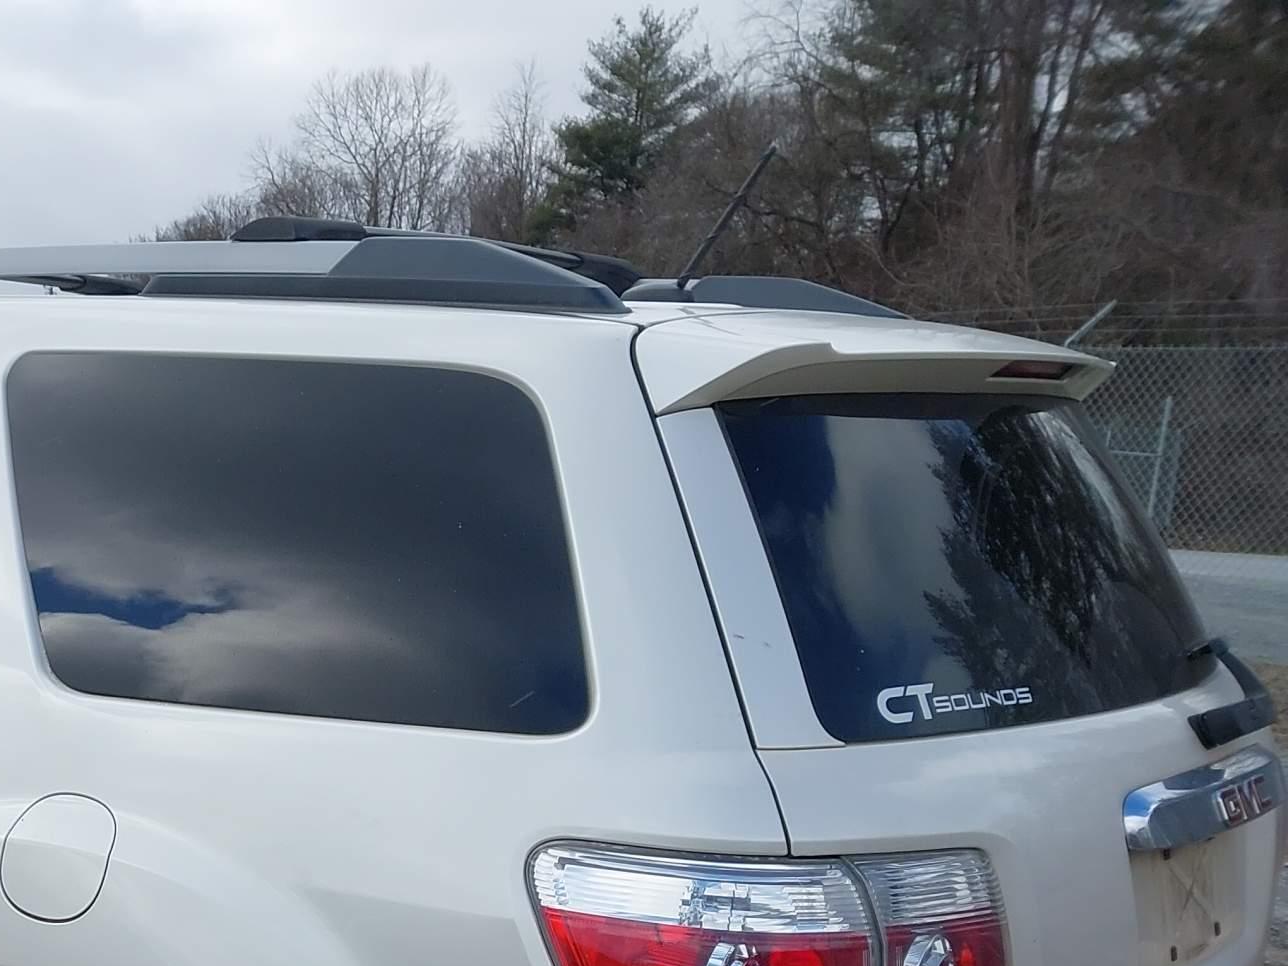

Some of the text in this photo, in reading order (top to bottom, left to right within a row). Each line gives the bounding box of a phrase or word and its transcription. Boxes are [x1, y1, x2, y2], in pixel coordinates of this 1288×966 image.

[876, 682, 1033, 724] CT SOUNDS
[1216, 773, 1273, 829] GMC
